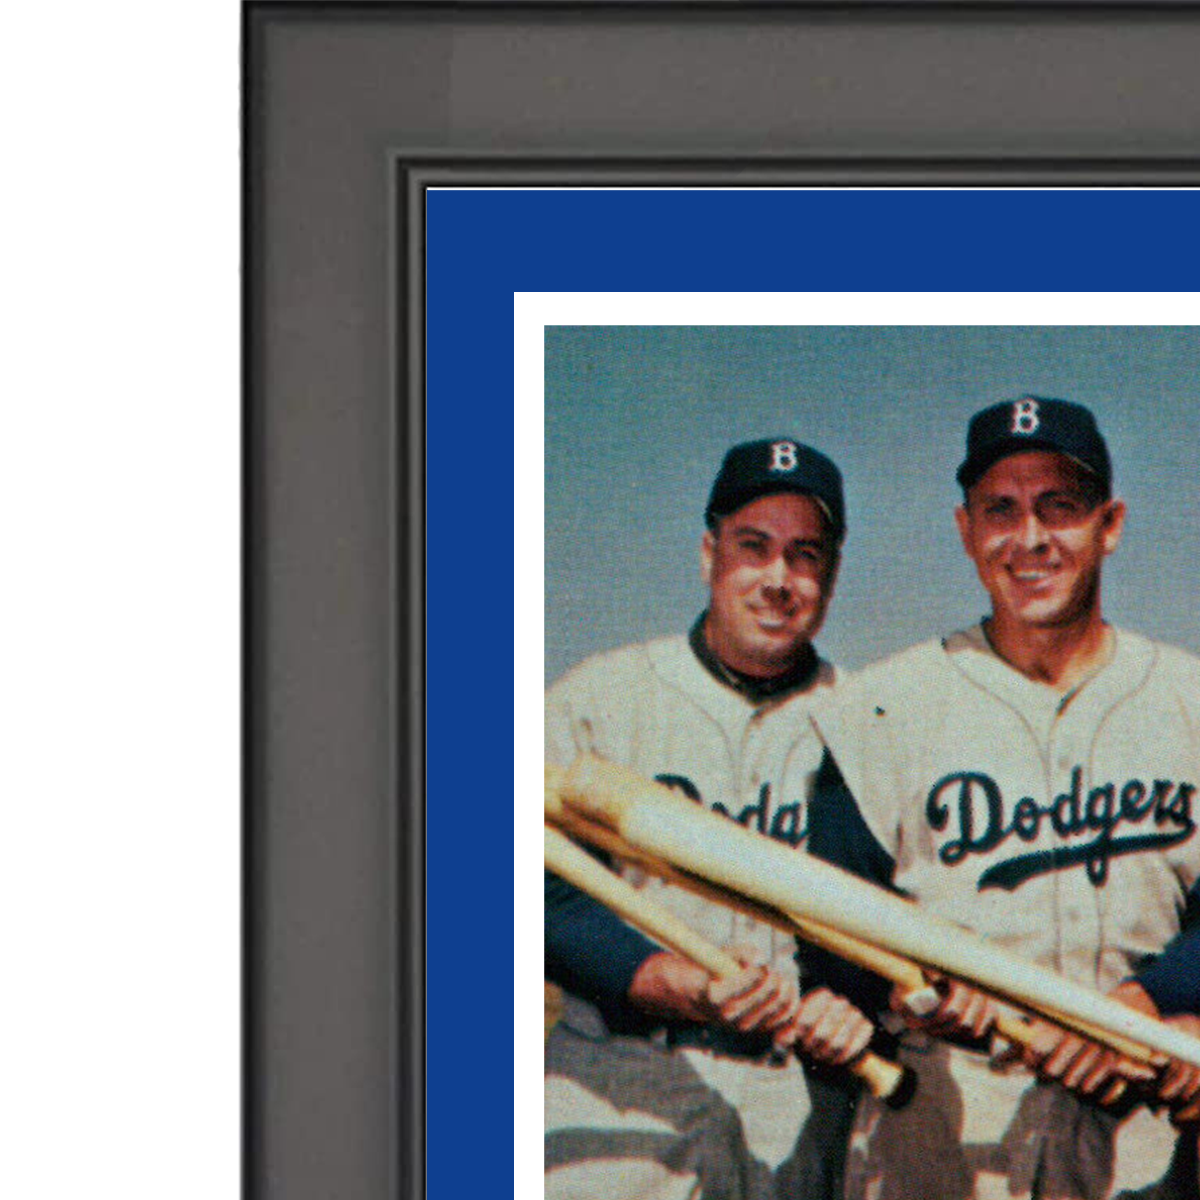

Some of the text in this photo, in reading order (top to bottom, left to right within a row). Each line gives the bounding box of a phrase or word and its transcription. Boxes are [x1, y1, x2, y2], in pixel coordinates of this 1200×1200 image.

[1010, 398, 1041, 437] B
[769, 440, 799, 473] B
[925, 765, 1198, 888] Dodgers
